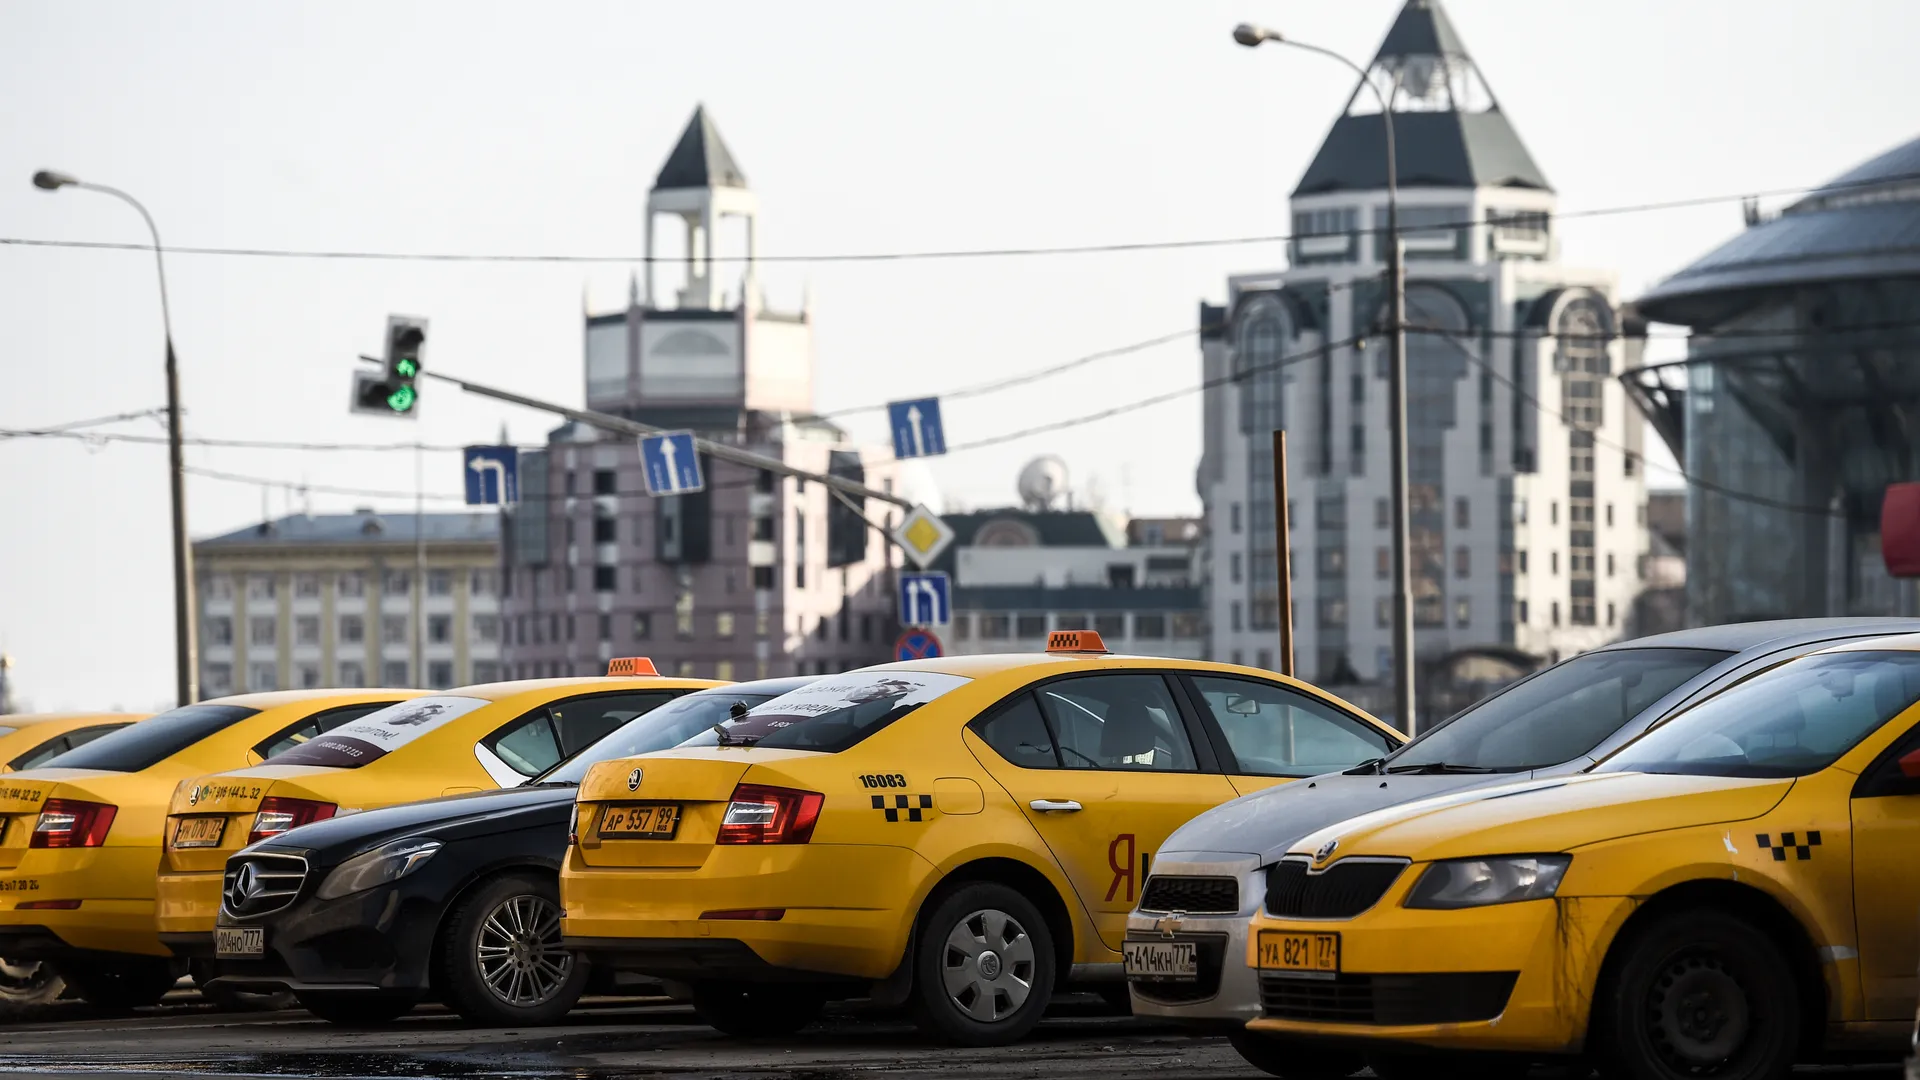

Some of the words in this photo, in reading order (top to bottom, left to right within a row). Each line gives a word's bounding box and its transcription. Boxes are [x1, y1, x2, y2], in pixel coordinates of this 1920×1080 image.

[858, 774, 907, 788] 16083
[250, 788, 261, 800] 32
[626, 808, 653, 831] 557
[658, 808, 673, 825] 99
[243, 930, 261, 946] 777
[1173, 944, 1192, 964] 777
[1283, 937, 1309, 966] 821
[1317, 936, 1333, 958] 77
